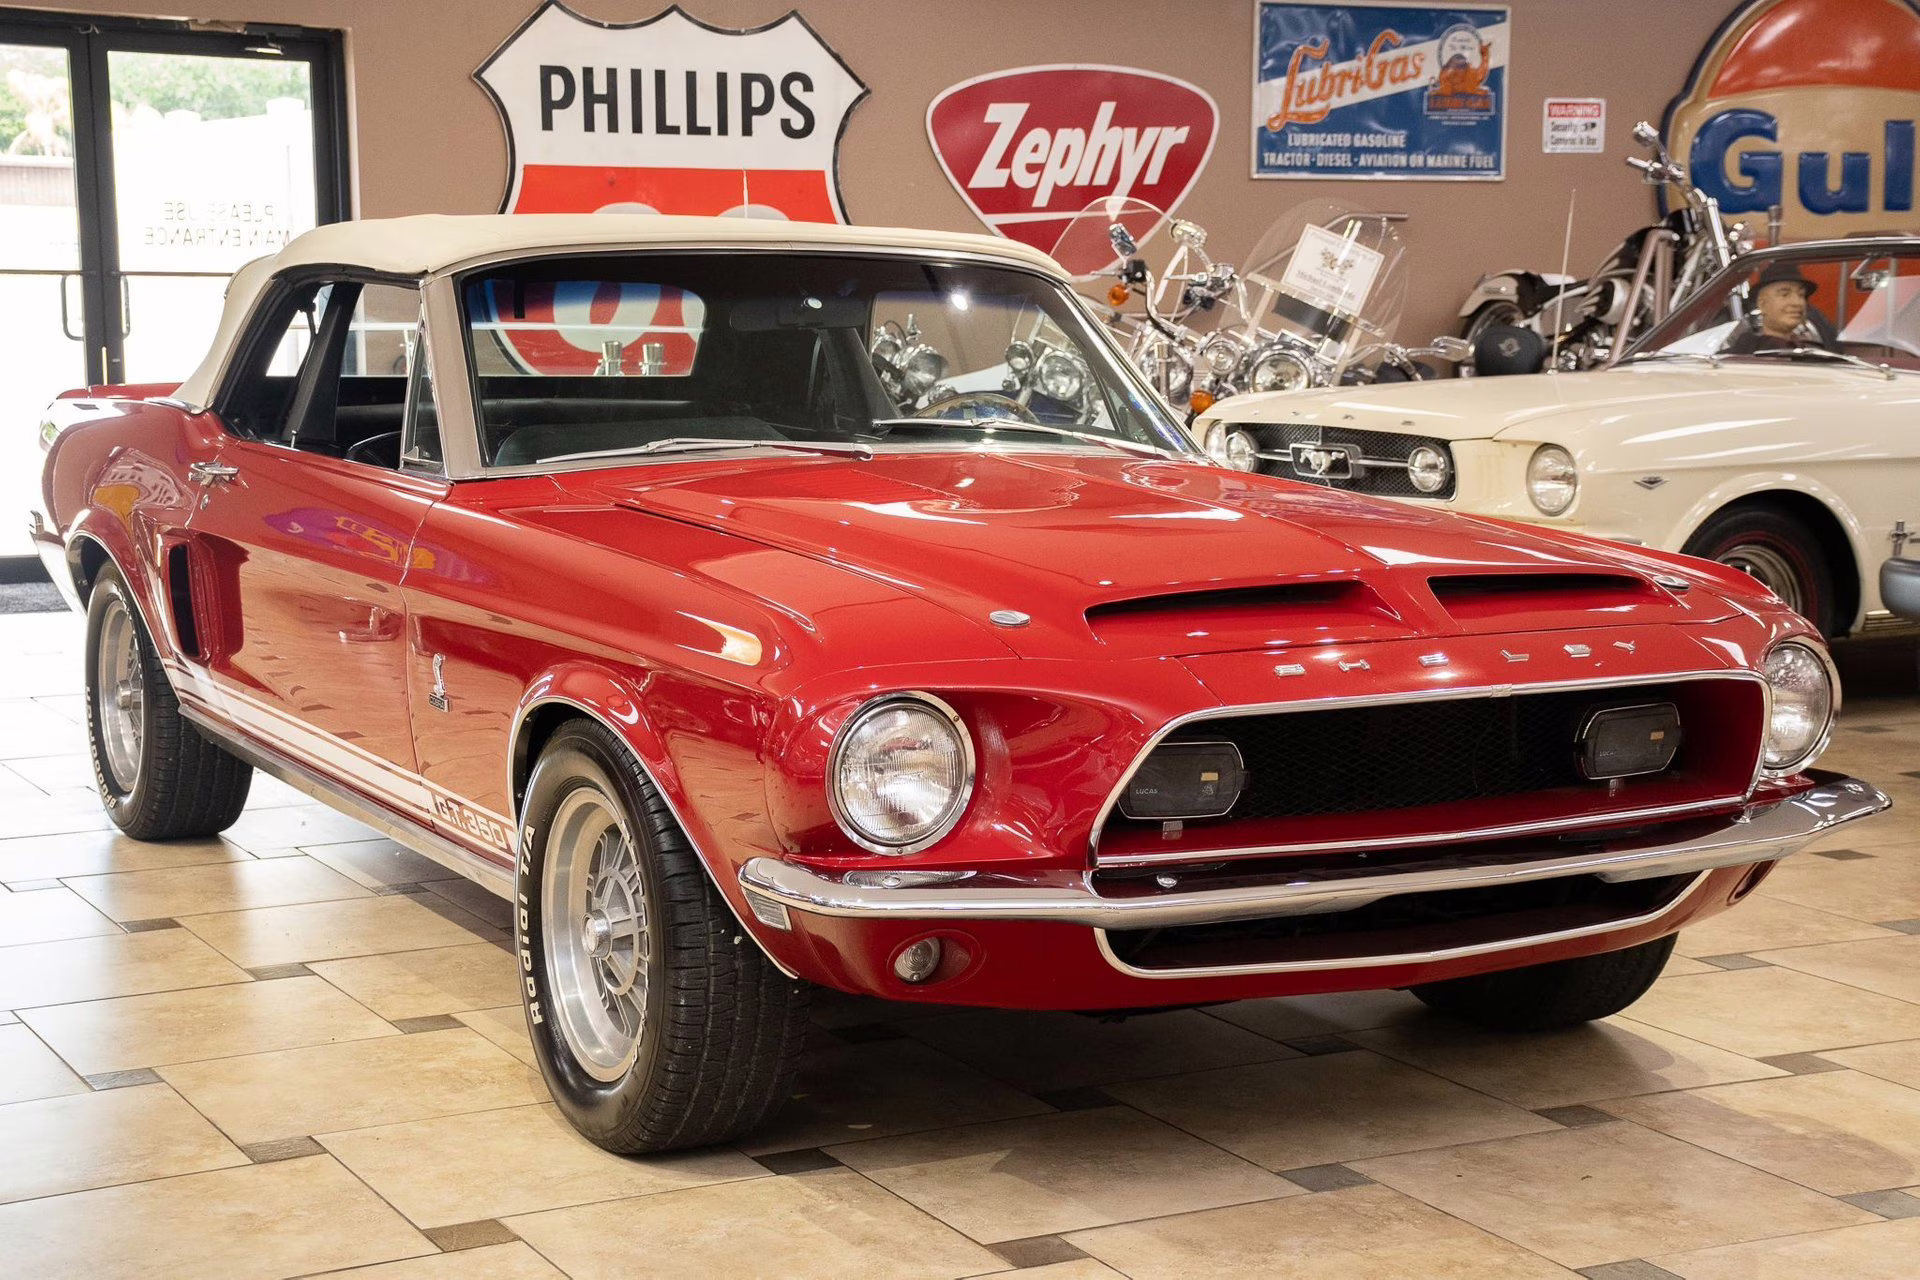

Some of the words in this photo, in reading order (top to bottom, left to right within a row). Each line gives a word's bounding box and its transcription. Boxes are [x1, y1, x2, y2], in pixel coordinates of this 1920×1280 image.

[540, 65, 815, 139] PHILLIPS
[1550, 105, 1600, 116] WARNING
[967, 101, 1191, 222] Zephyr
[1263, 152, 1311, 166] TRACTOR
[1316, 152, 1351, 167] DIESEL
[1359, 153, 1408, 168] AVIATION
[1409, 154, 1425, 168] OR
[1426, 154, 1468, 168] MARINE
[1469, 154, 1494, 168] FUEL
[1287, 133, 1351, 147] LUBRICATED
[1353, 133, 1407, 148] GASOLINE
[520, 824, 536, 876] T/A
[519, 892, 544, 1025] Radial
